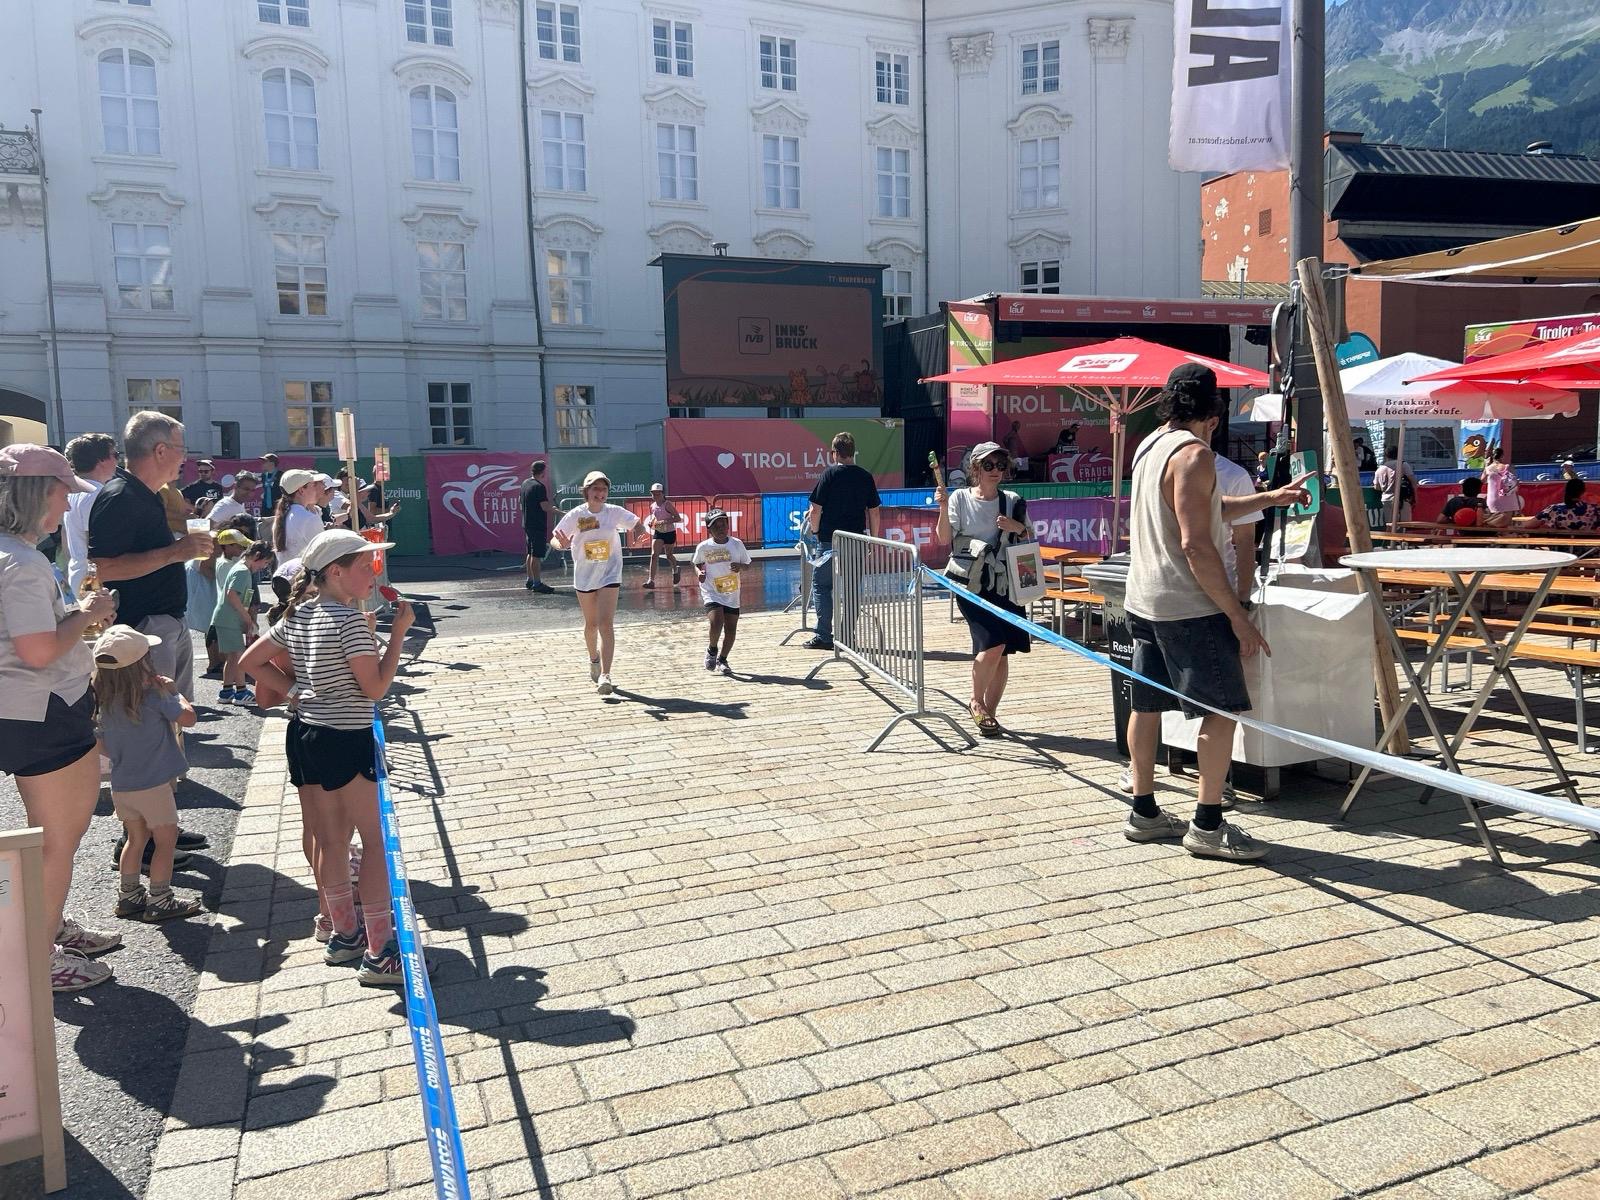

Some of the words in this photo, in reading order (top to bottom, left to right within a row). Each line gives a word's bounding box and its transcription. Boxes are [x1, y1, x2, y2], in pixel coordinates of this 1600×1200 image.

[1537, 325, 1574, 341] Tiroler
[776, 337, 818, 350] BRUCK
[1385, 398, 1440, 407] Braukunst
[1364, 407, 1382, 416] auf
[1385, 407, 1430, 416] höchster
[741, 451, 798, 469] TIROL
[609, 482, 645, 494] szeitung
[483, 497, 523, 511] FRAU
[483, 510, 518, 524] LAUF
